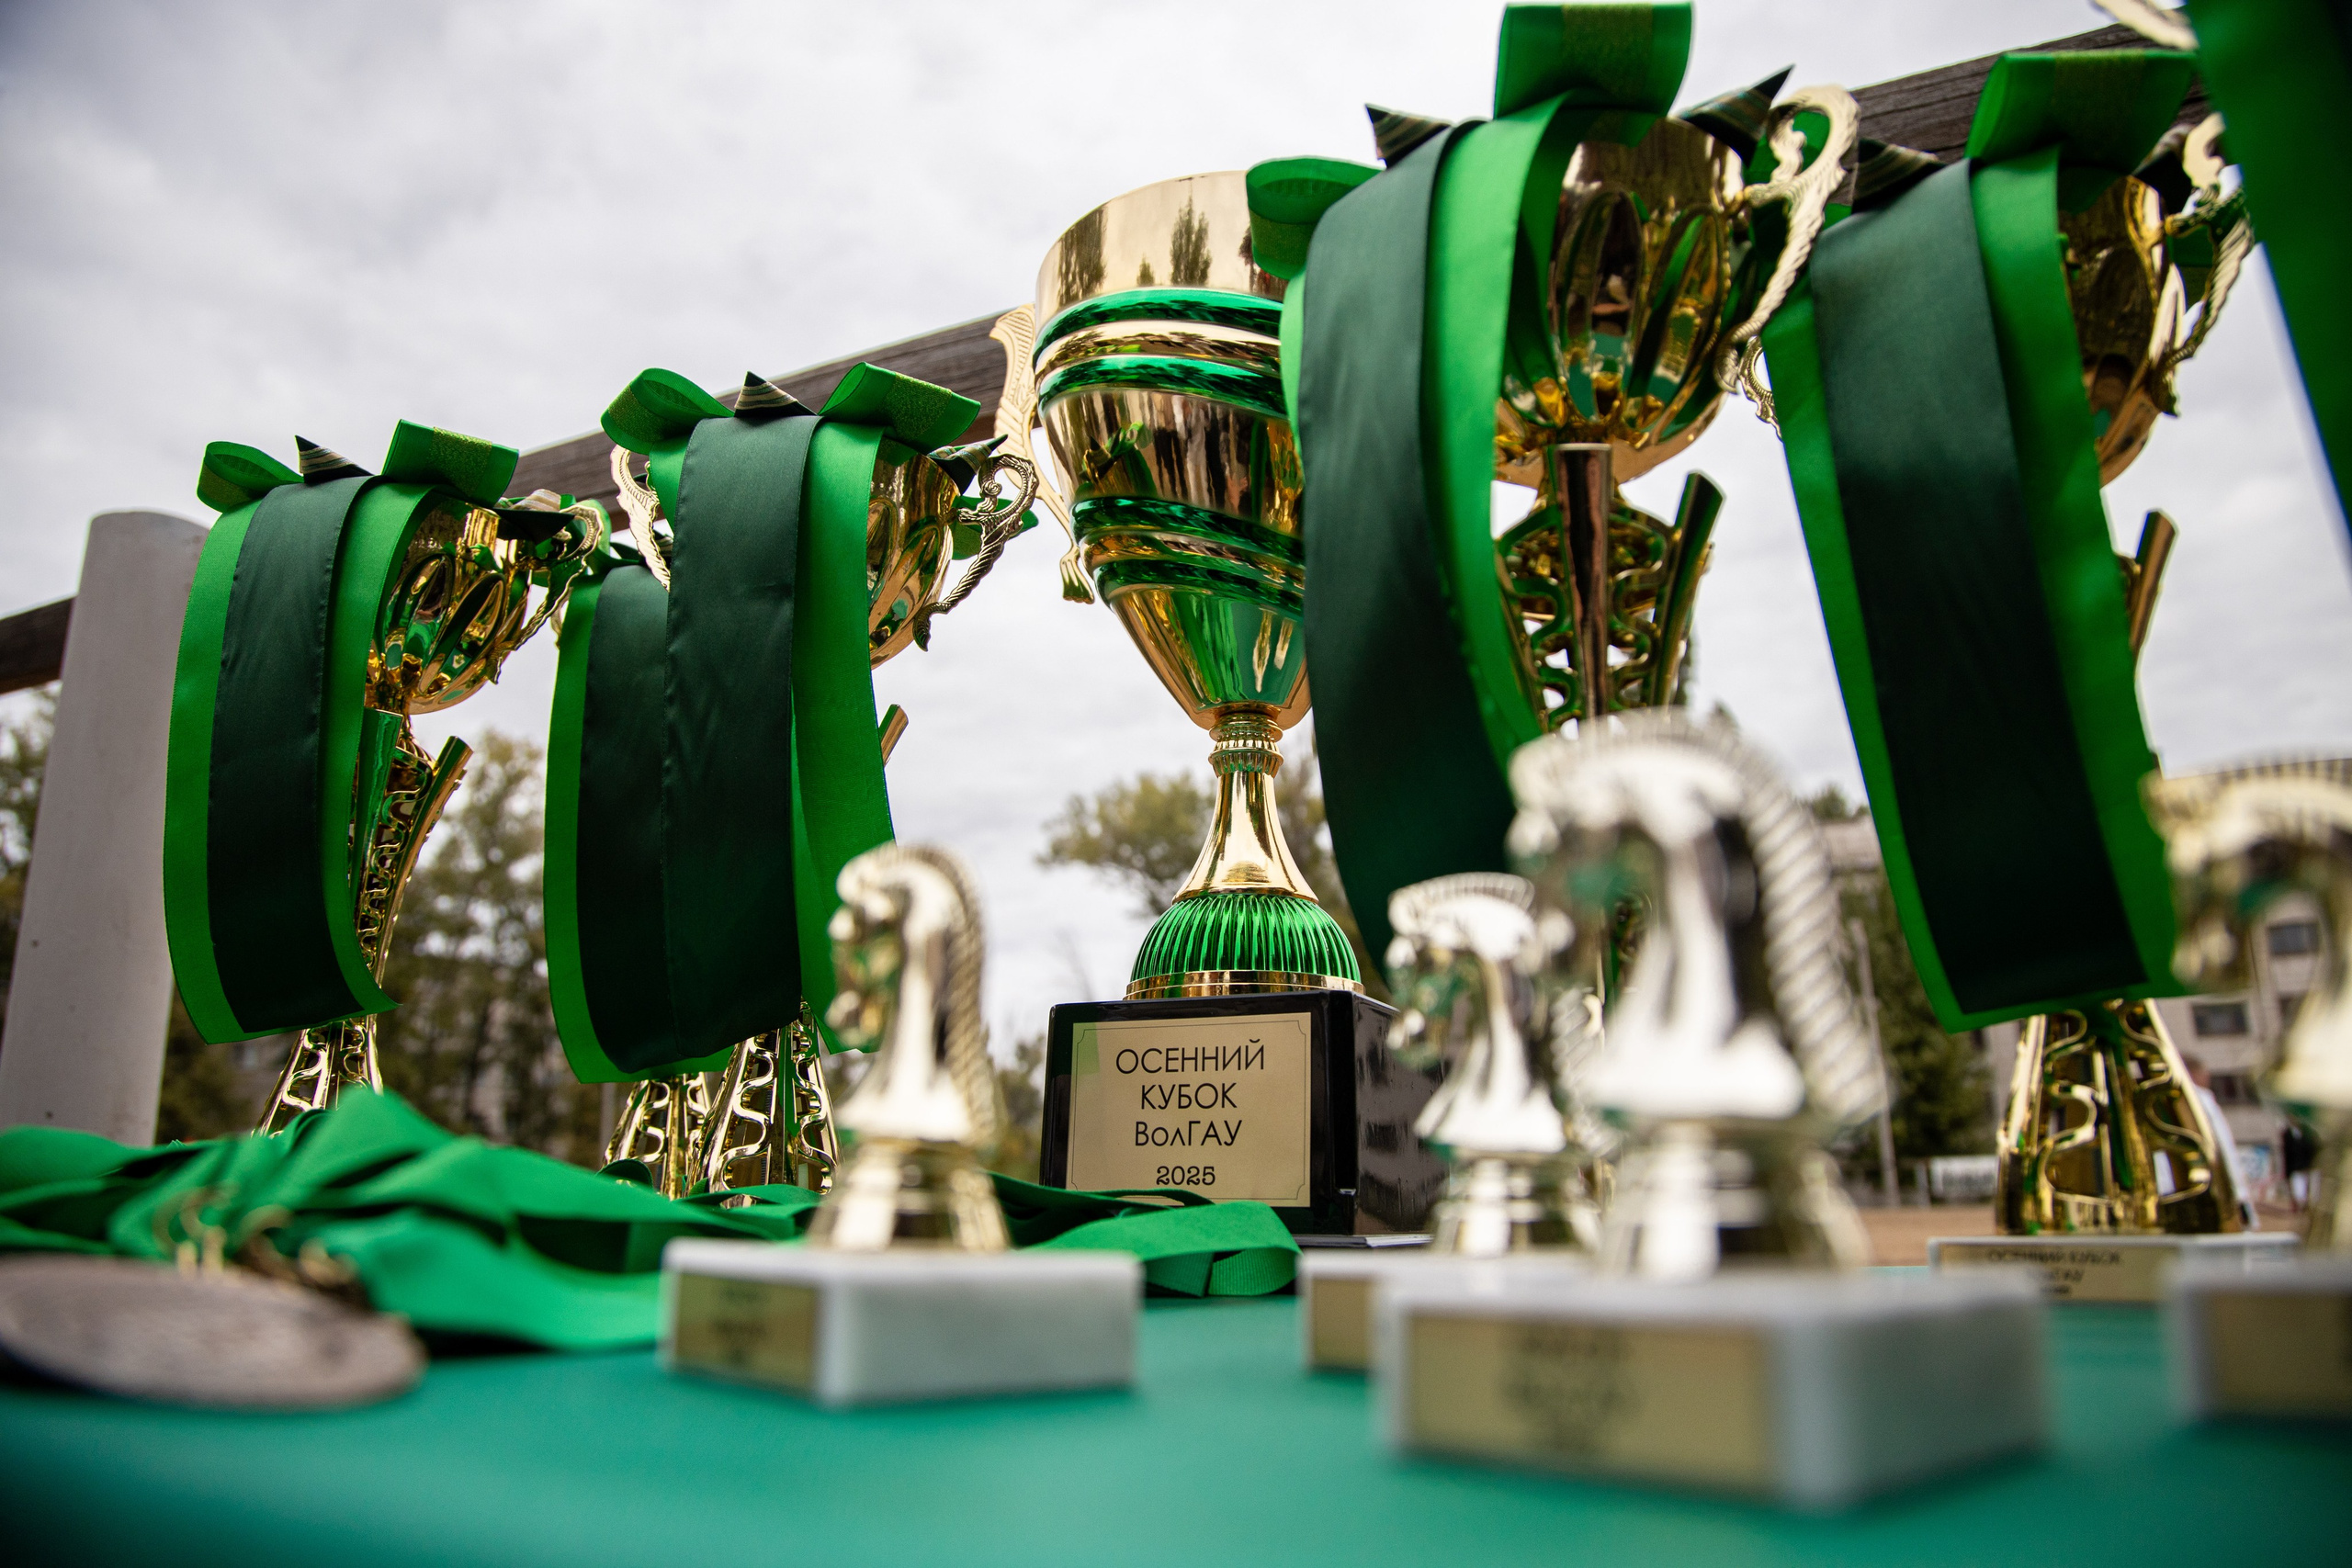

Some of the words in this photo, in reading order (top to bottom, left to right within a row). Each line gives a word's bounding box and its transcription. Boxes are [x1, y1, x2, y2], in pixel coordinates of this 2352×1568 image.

[1115, 1038, 1264, 1075] ОСЕННИЙ
[1140, 1082, 1238, 1111] КУБОК
[1135, 1119, 1243, 1147] ВолГАУ
[1156, 1165, 1216, 1186] 2025
